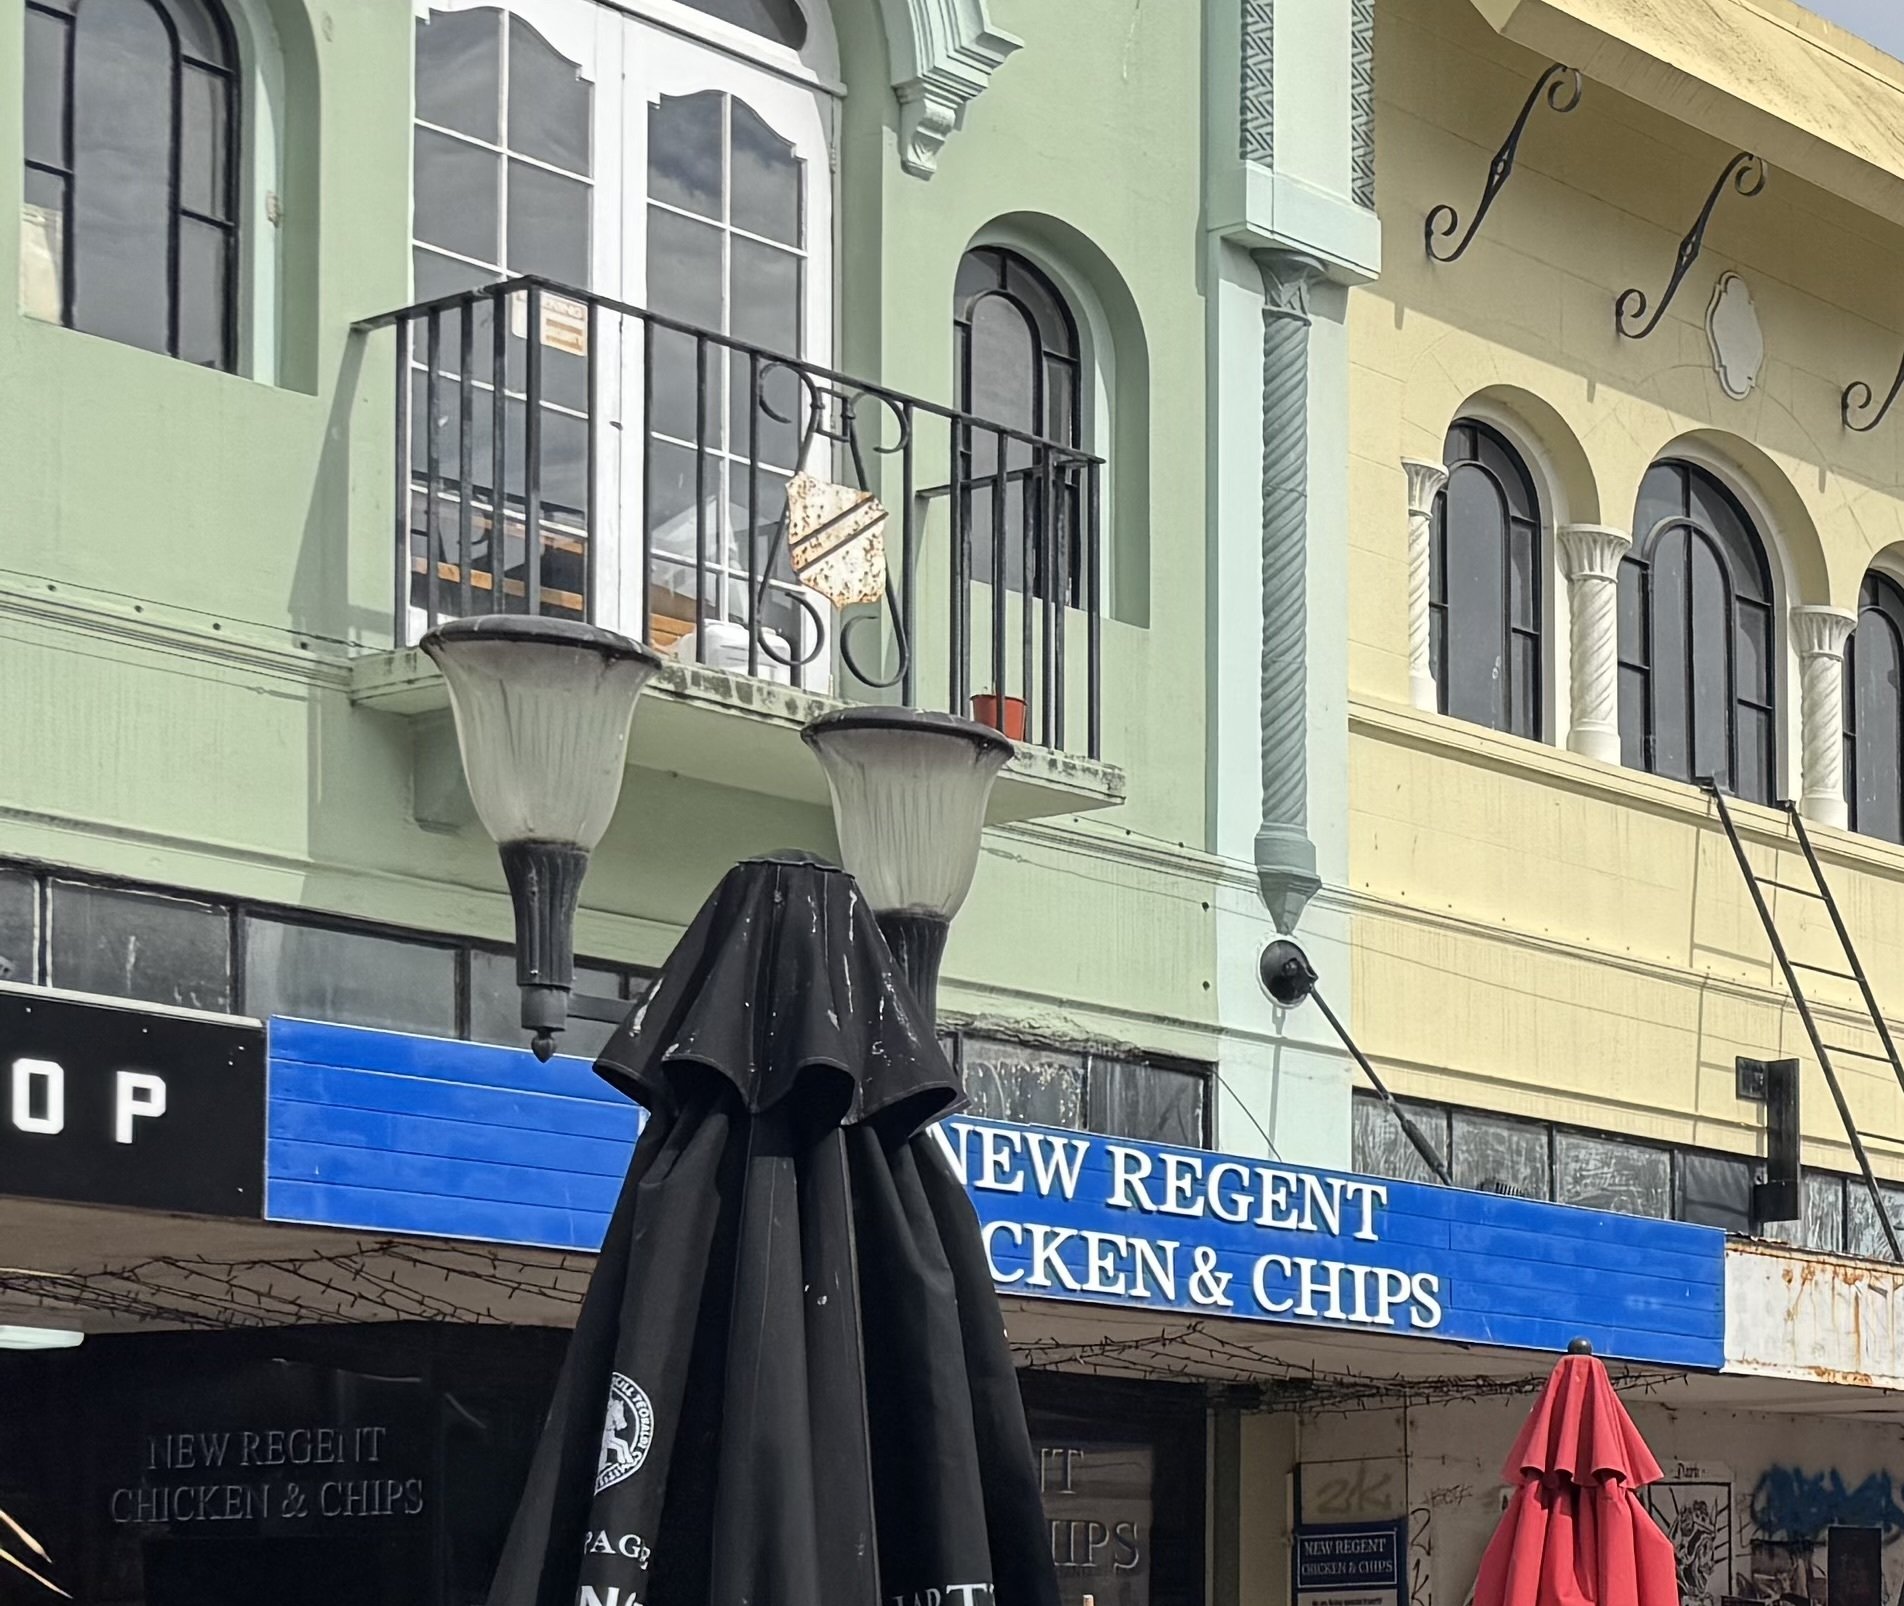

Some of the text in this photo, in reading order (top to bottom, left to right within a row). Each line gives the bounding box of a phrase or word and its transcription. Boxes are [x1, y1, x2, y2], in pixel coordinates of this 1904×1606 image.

[928, 1121, 1388, 1242] NEW REGENT
[982, 1219, 1443, 1330] CKEN & CHIPS
[145, 1425, 388, 1471] NEW REGENT
[108, 1476, 426, 1525] CHICKEN & CHIPS
[1335, 1537, 1388, 1555] REGENT
[1357, 1559, 1394, 1575] CHIPS
